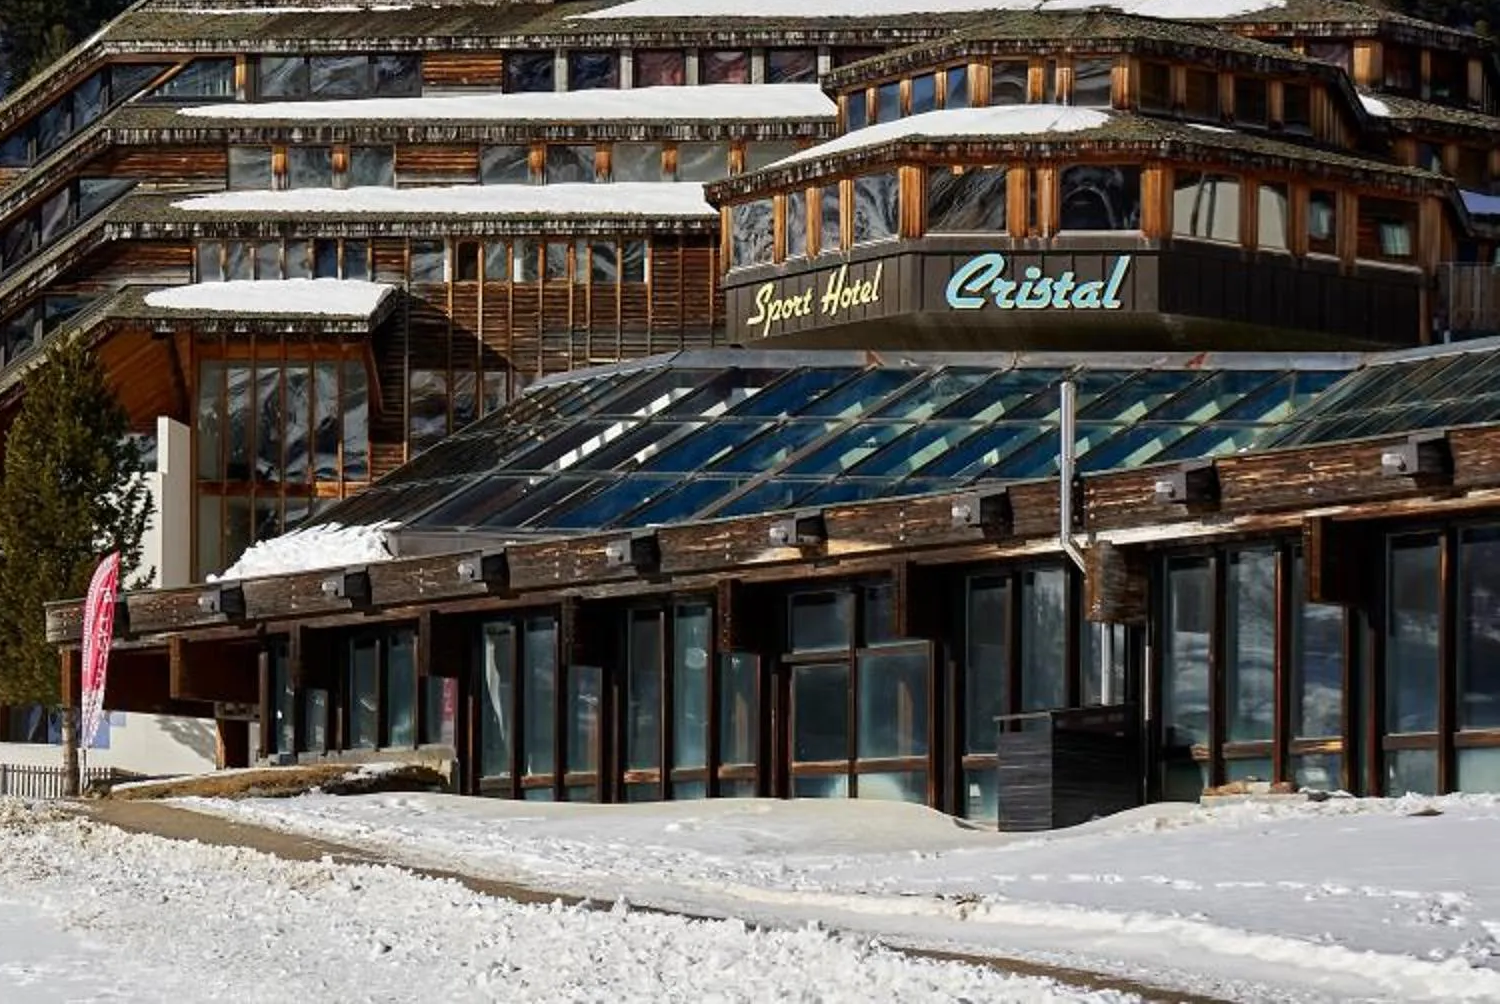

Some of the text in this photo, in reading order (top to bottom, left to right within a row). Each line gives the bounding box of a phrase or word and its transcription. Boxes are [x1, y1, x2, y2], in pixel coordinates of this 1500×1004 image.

[746, 262, 883, 337] Sport Hotel
[946, 252, 1131, 309] Cristal
